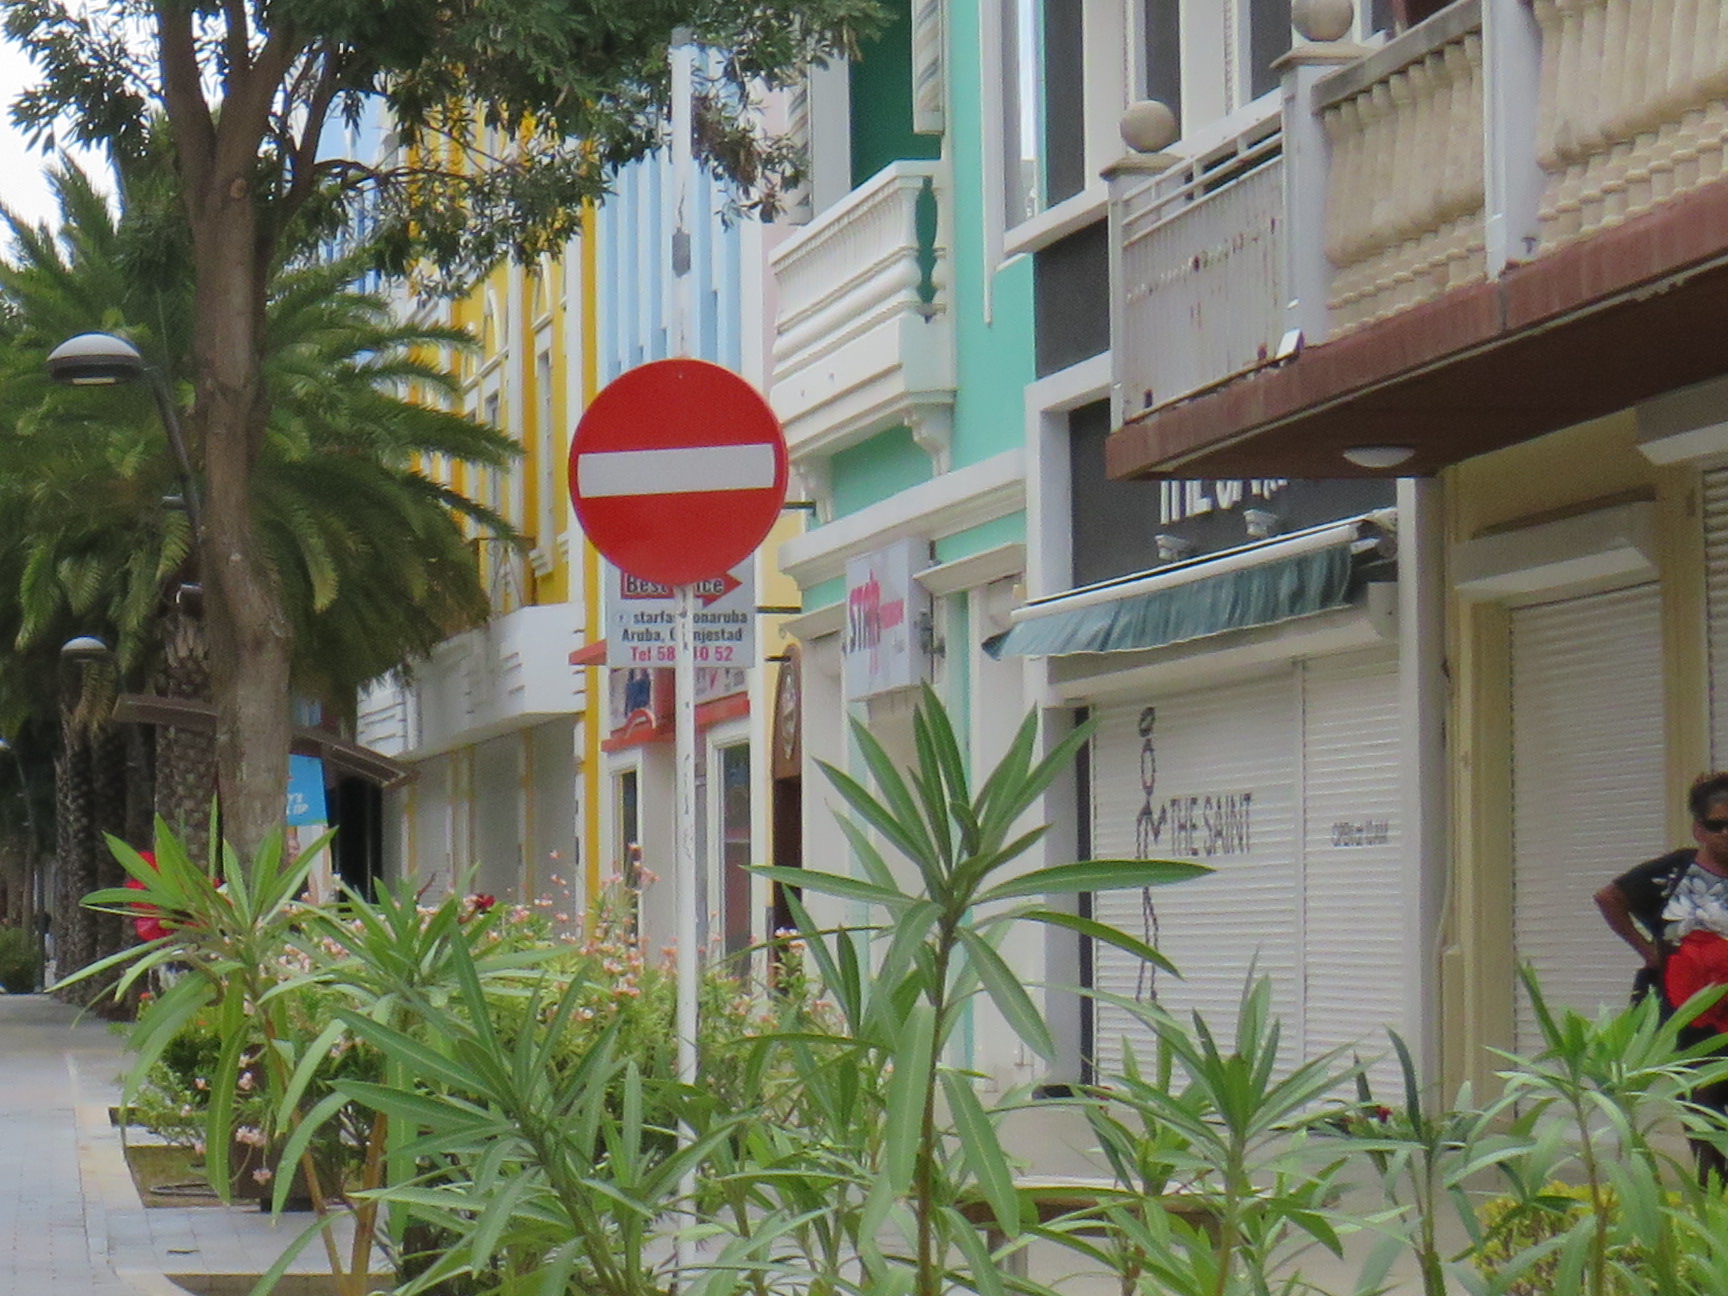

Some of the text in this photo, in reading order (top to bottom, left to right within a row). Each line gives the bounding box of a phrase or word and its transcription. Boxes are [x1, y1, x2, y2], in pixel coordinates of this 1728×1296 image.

[633, 609, 748, 624] starfaonaruba
[621, 628, 743, 643] Aruba, njestad
[631, 646, 652, 661] Tel
[715, 646, 733, 661] 52
